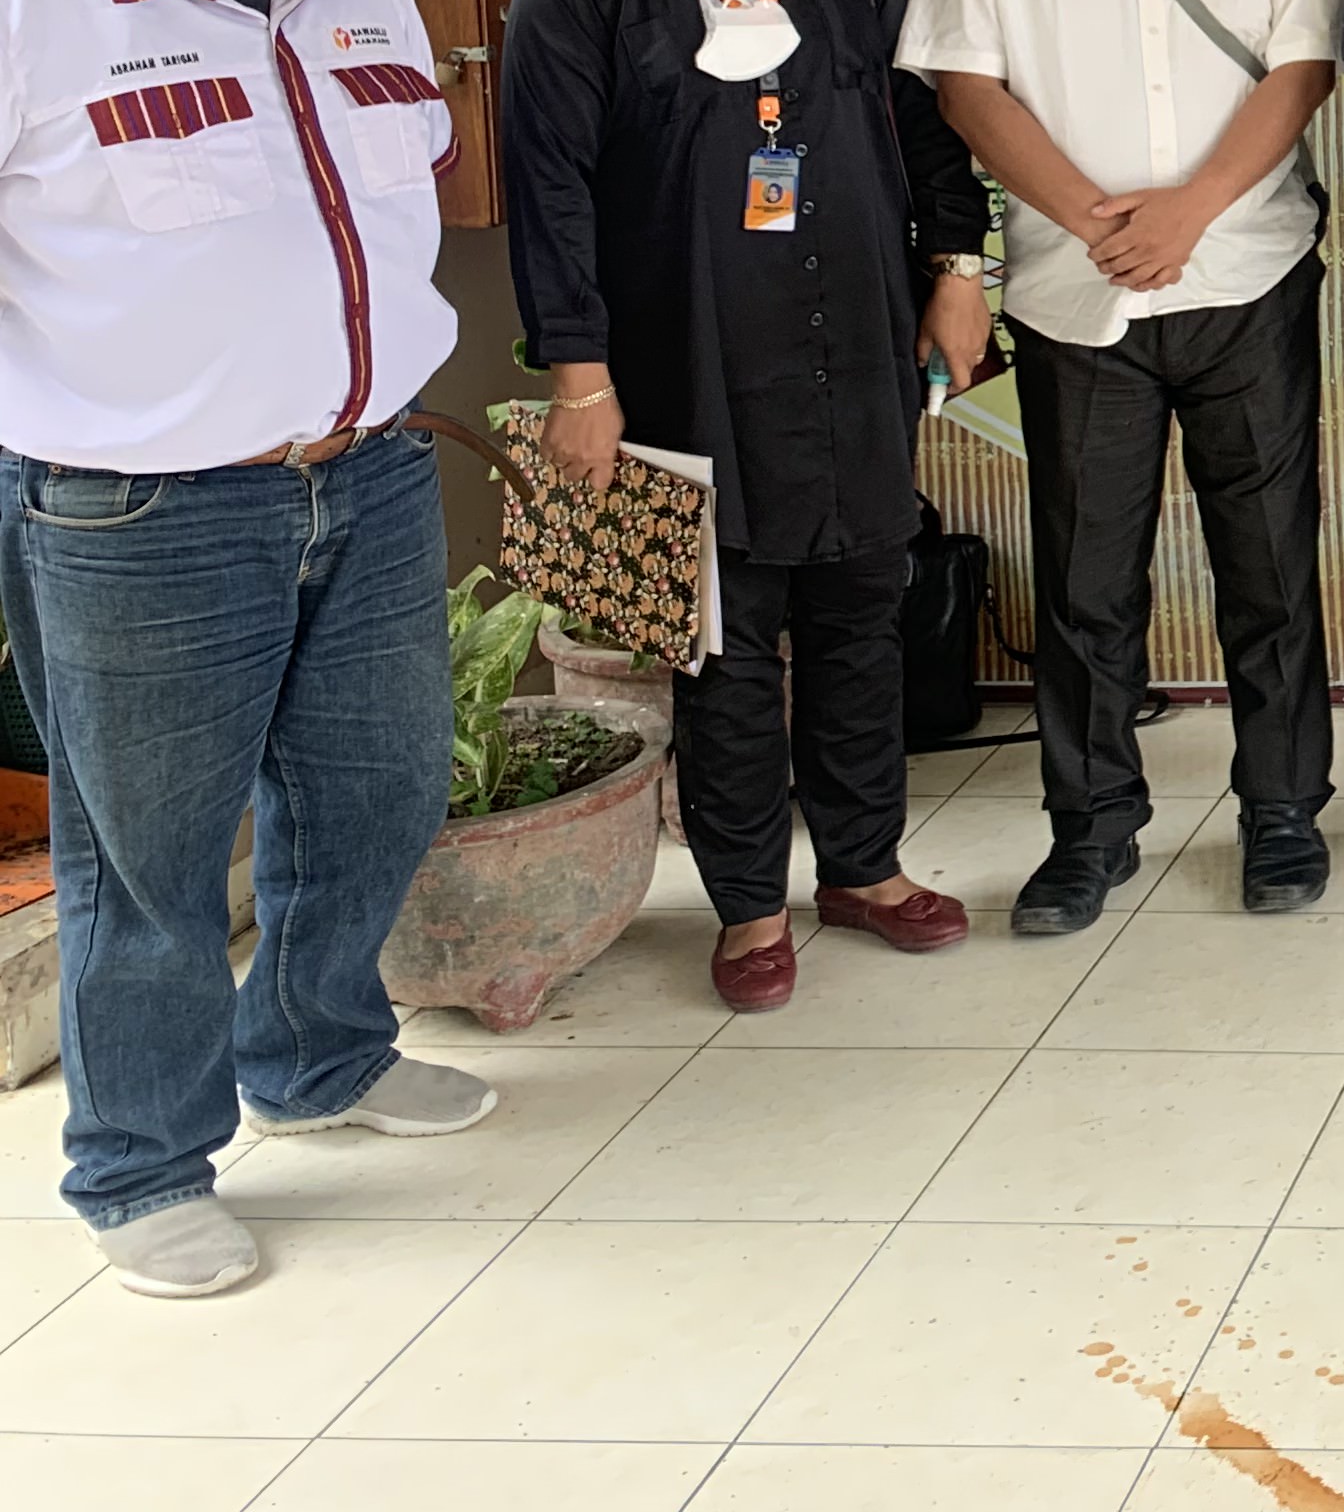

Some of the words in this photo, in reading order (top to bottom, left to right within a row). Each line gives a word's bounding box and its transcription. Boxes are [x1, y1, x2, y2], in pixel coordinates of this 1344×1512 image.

[350, 27, 387, 37] BAWASLU
[110, 57, 156, 76] ABRAHAM
[161, 52, 200, 67] TARIGAN
